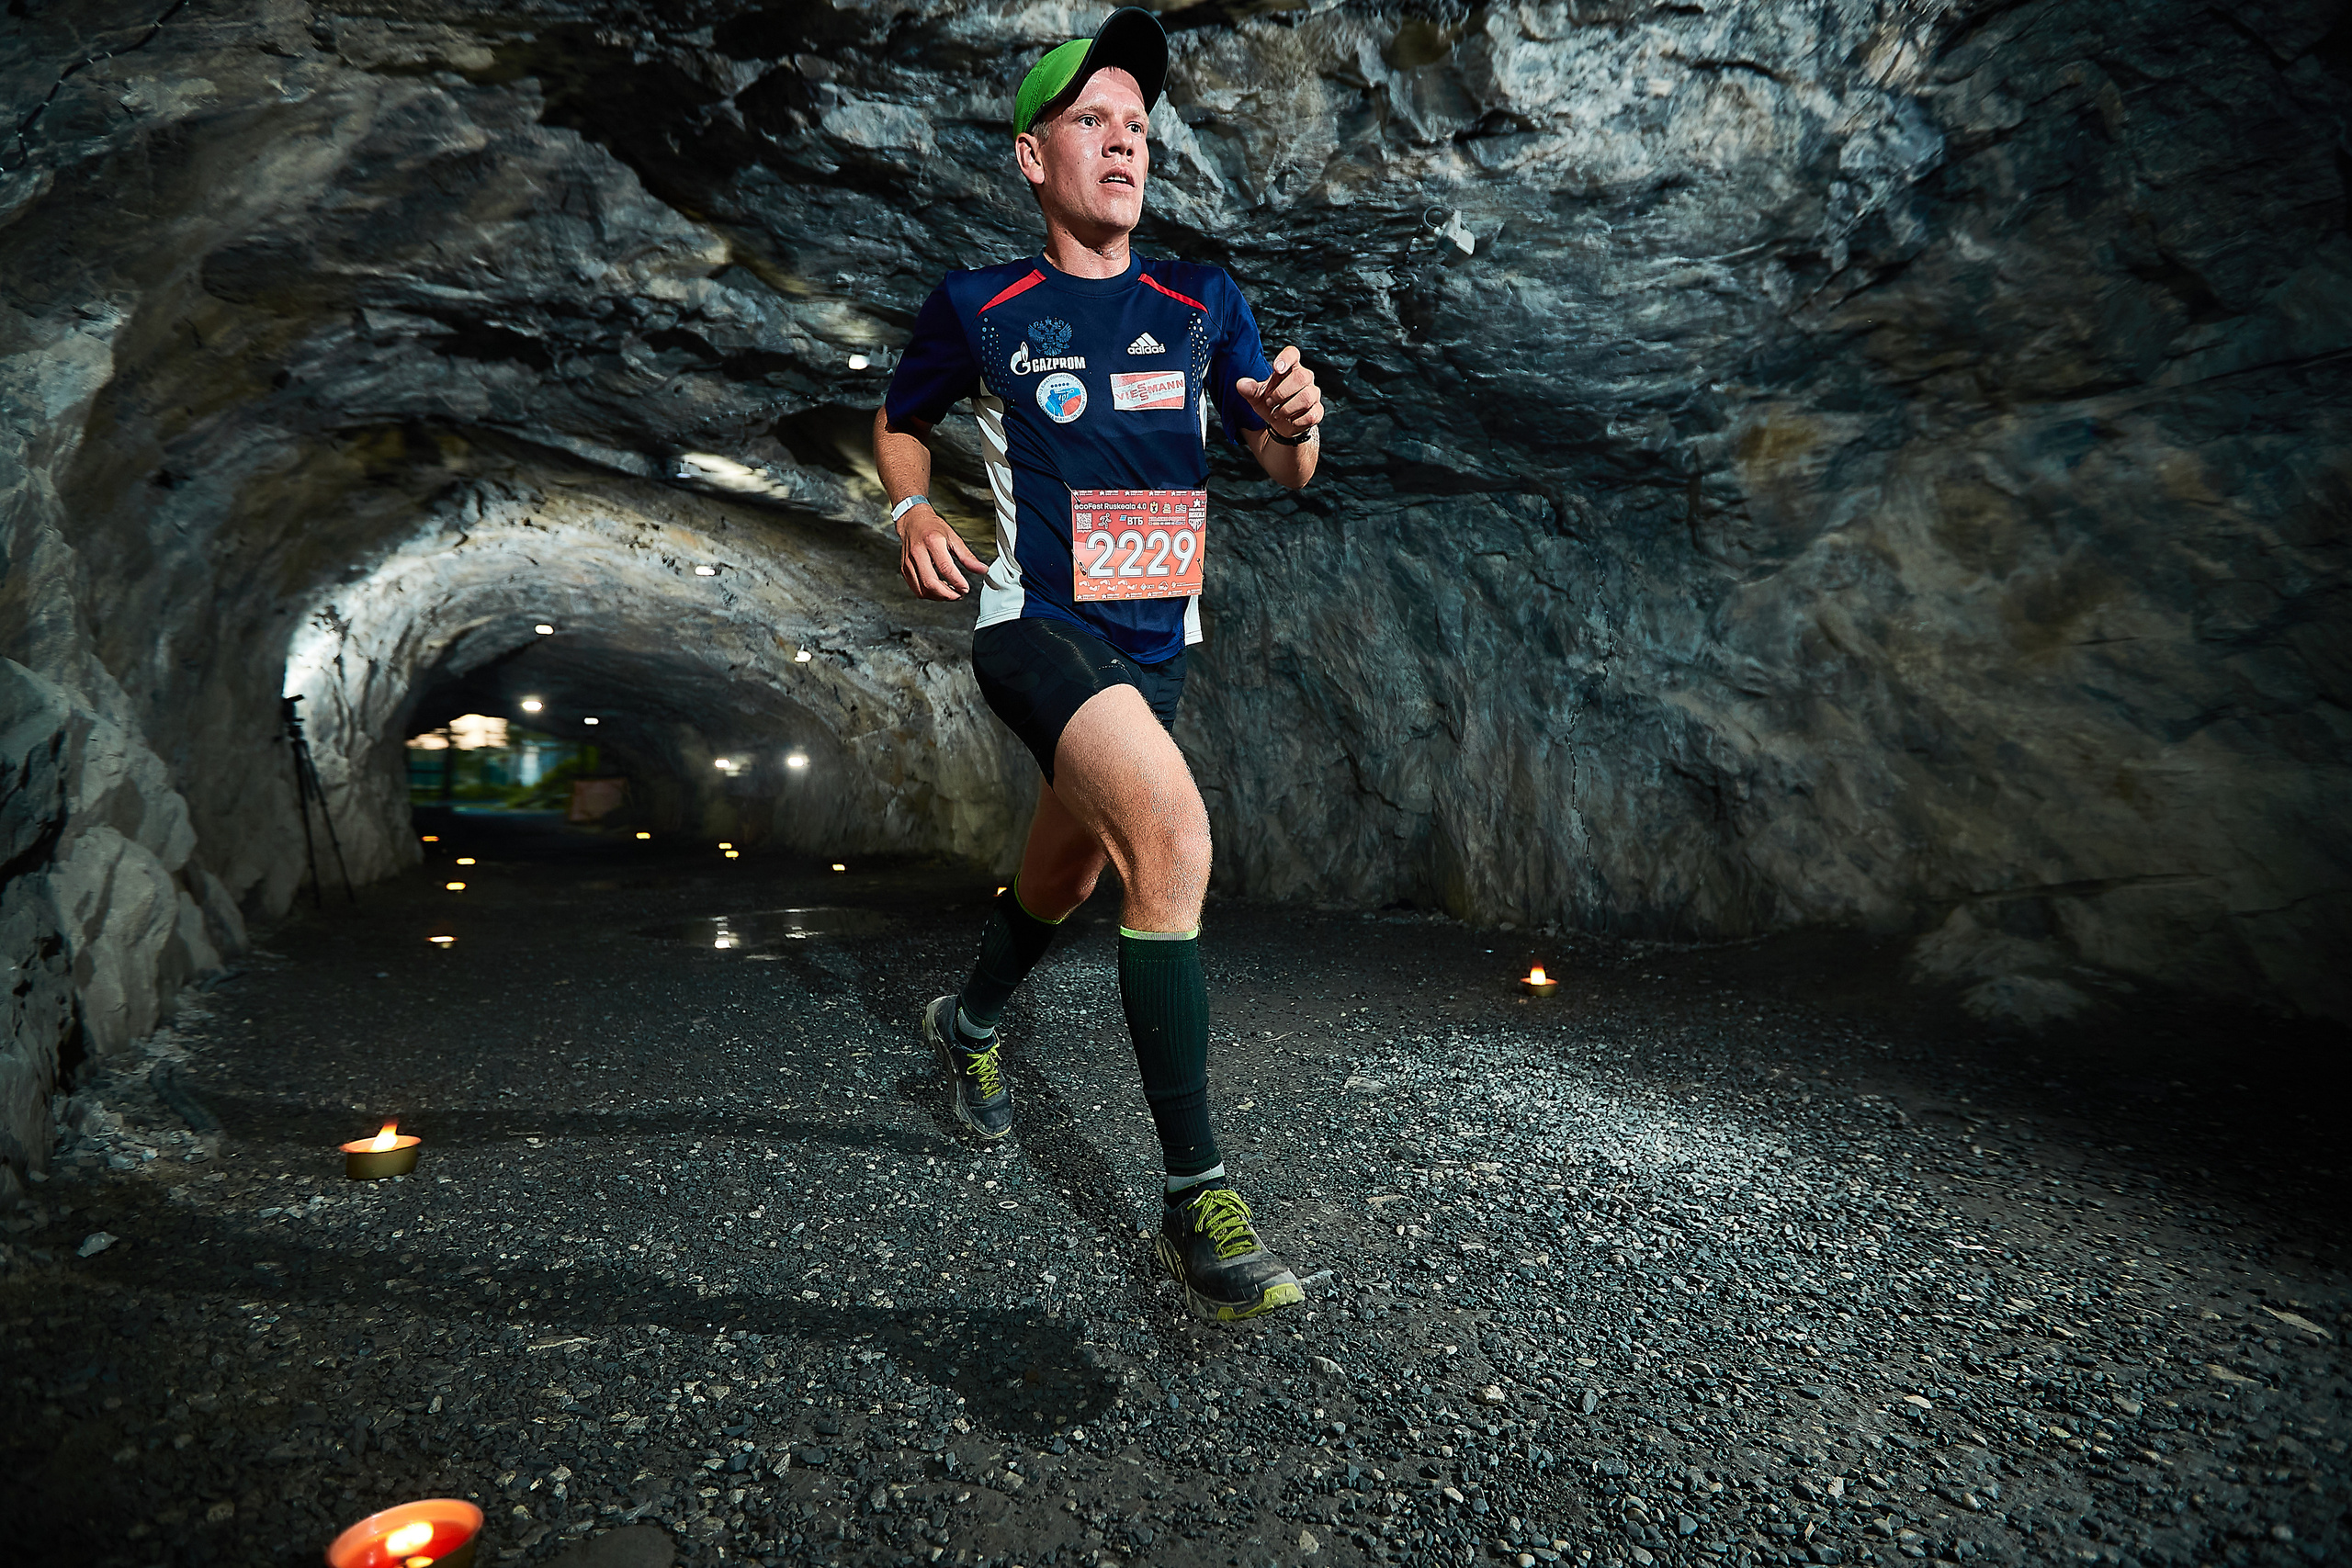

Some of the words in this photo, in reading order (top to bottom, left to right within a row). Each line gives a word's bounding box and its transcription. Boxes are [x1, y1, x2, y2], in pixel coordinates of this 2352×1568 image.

[1127, 344, 1166, 355] adidas
[1032, 356, 1086, 373] GAZPROM
[1115, 379, 1183, 400] VIESSMANN
[1073, 502, 1103, 511] ecoFest
[1103, 502, 1136, 511] Ruskeala
[1136, 502, 1148, 511] 4.0
[1126, 516, 1144, 525] ВТБ
[1085, 528, 1197, 579] 2229
